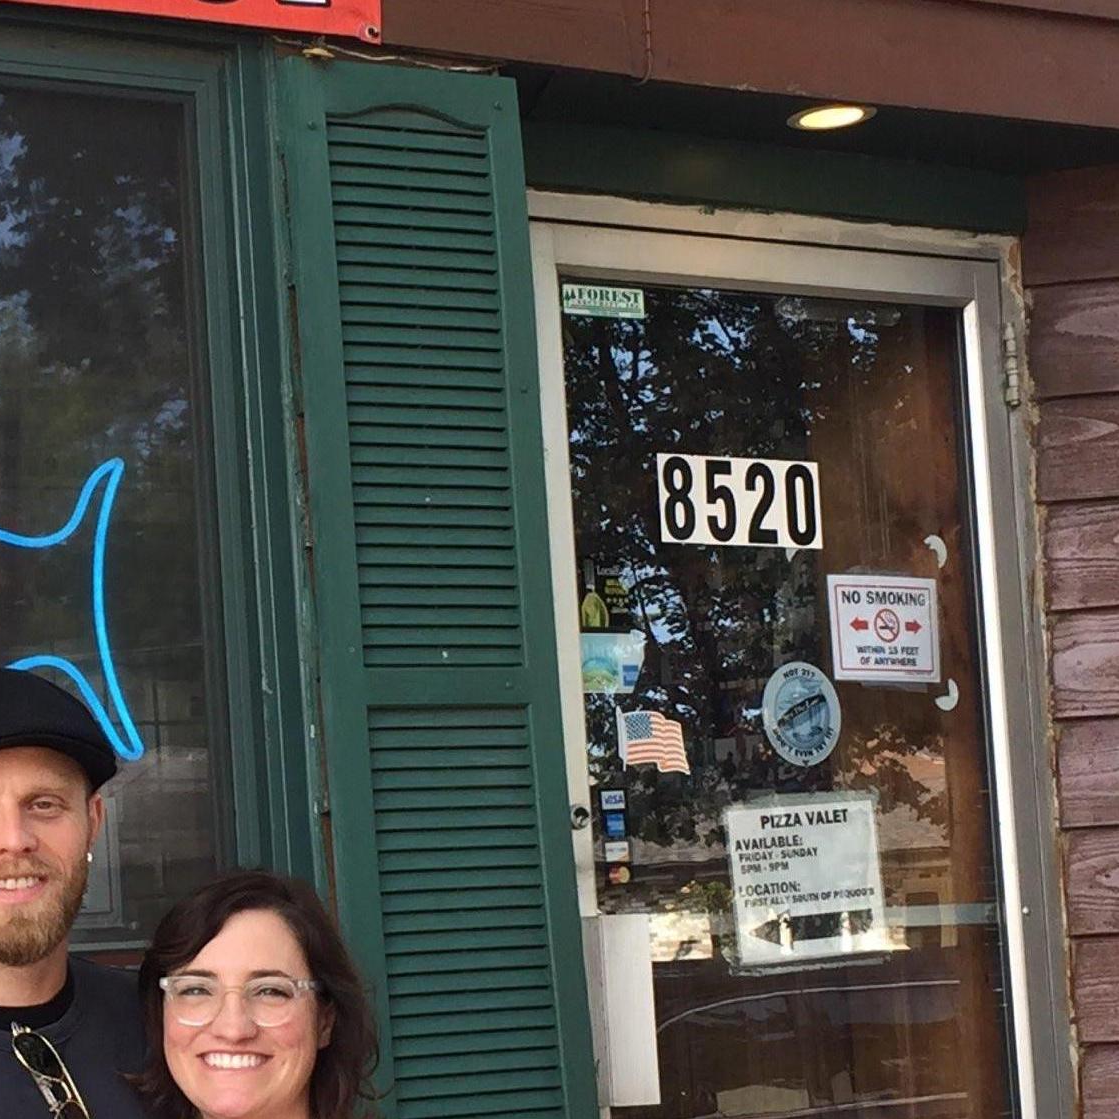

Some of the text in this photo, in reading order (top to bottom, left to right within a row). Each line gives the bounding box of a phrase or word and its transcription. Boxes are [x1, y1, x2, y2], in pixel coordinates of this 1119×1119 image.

[578, 288, 641, 303] FOREST
[662, 456, 817, 547] 8520
[841, 590, 926, 606] NO SMOKING
[856, 645, 886, 654] WITHIN
[900, 646, 920, 656] FEET
[860, 656, 917, 667] OF ANYWHERE
[783, 668, 799, 679] NOT
[794, 748, 814, 757] EVEN
[760, 808, 848, 829] PIZZA VALET
[735, 834, 803, 851] AVAILABLE:
[739, 851, 773, 863] FRIDAY
[781, 847, 818, 859] SUNDAY
[741, 863, 762, 874] 5PM
[770, 861, 789, 872] 9PM
[738, 880, 801, 897] LOCATION:
[744, 897, 768, 908] FIRST
[792, 892, 819, 903] SOUTH
[821, 890, 832, 900] OF
